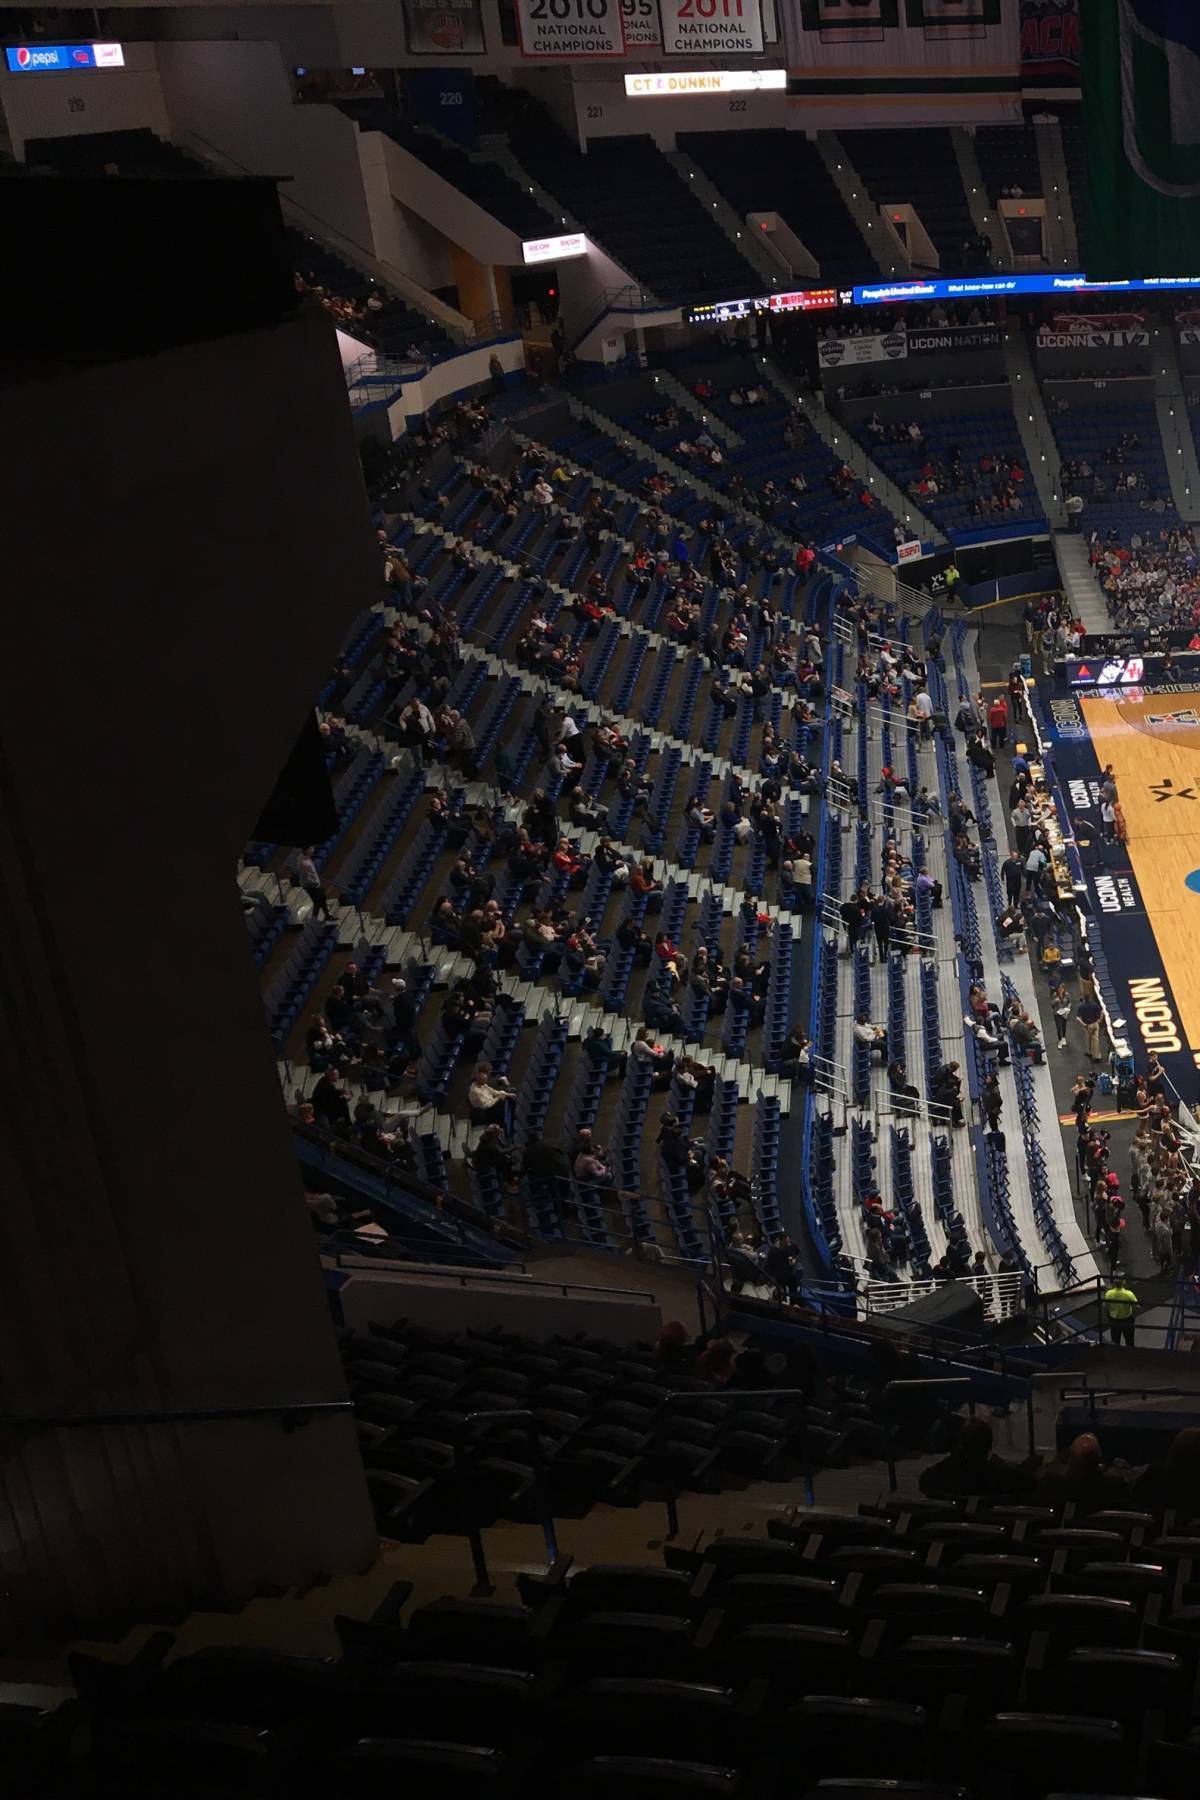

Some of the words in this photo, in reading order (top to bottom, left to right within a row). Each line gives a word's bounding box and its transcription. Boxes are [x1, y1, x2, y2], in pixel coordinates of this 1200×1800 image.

[530, 0, 608, 19] 2010
[676, 0, 742, 18] 2011
[537, 24, 605, 36] NATIONAL
[678, 23, 746, 34] NATIONAL
[626, 33, 658, 42] PIONS
[675, 38, 753, 50] CHAMPIONS
[533, 40, 613, 51] CHAMPIONS
[32, 50, 59, 67] pepsi
[633, 79, 650, 91] CT
[440, 92, 462, 105] 220
[729, 101, 747, 112] 222
[910, 337, 952, 349] UCONN
[1036, 335, 1088, 348] UCONN
[1050, 699, 1086, 738] UCONN
[1067, 780, 1092, 809] UCONN
[1094, 875, 1121, 912] UCONN
[1117, 878, 1136, 907] HEALTH
[1128, 977, 1182, 1054] UCONN
